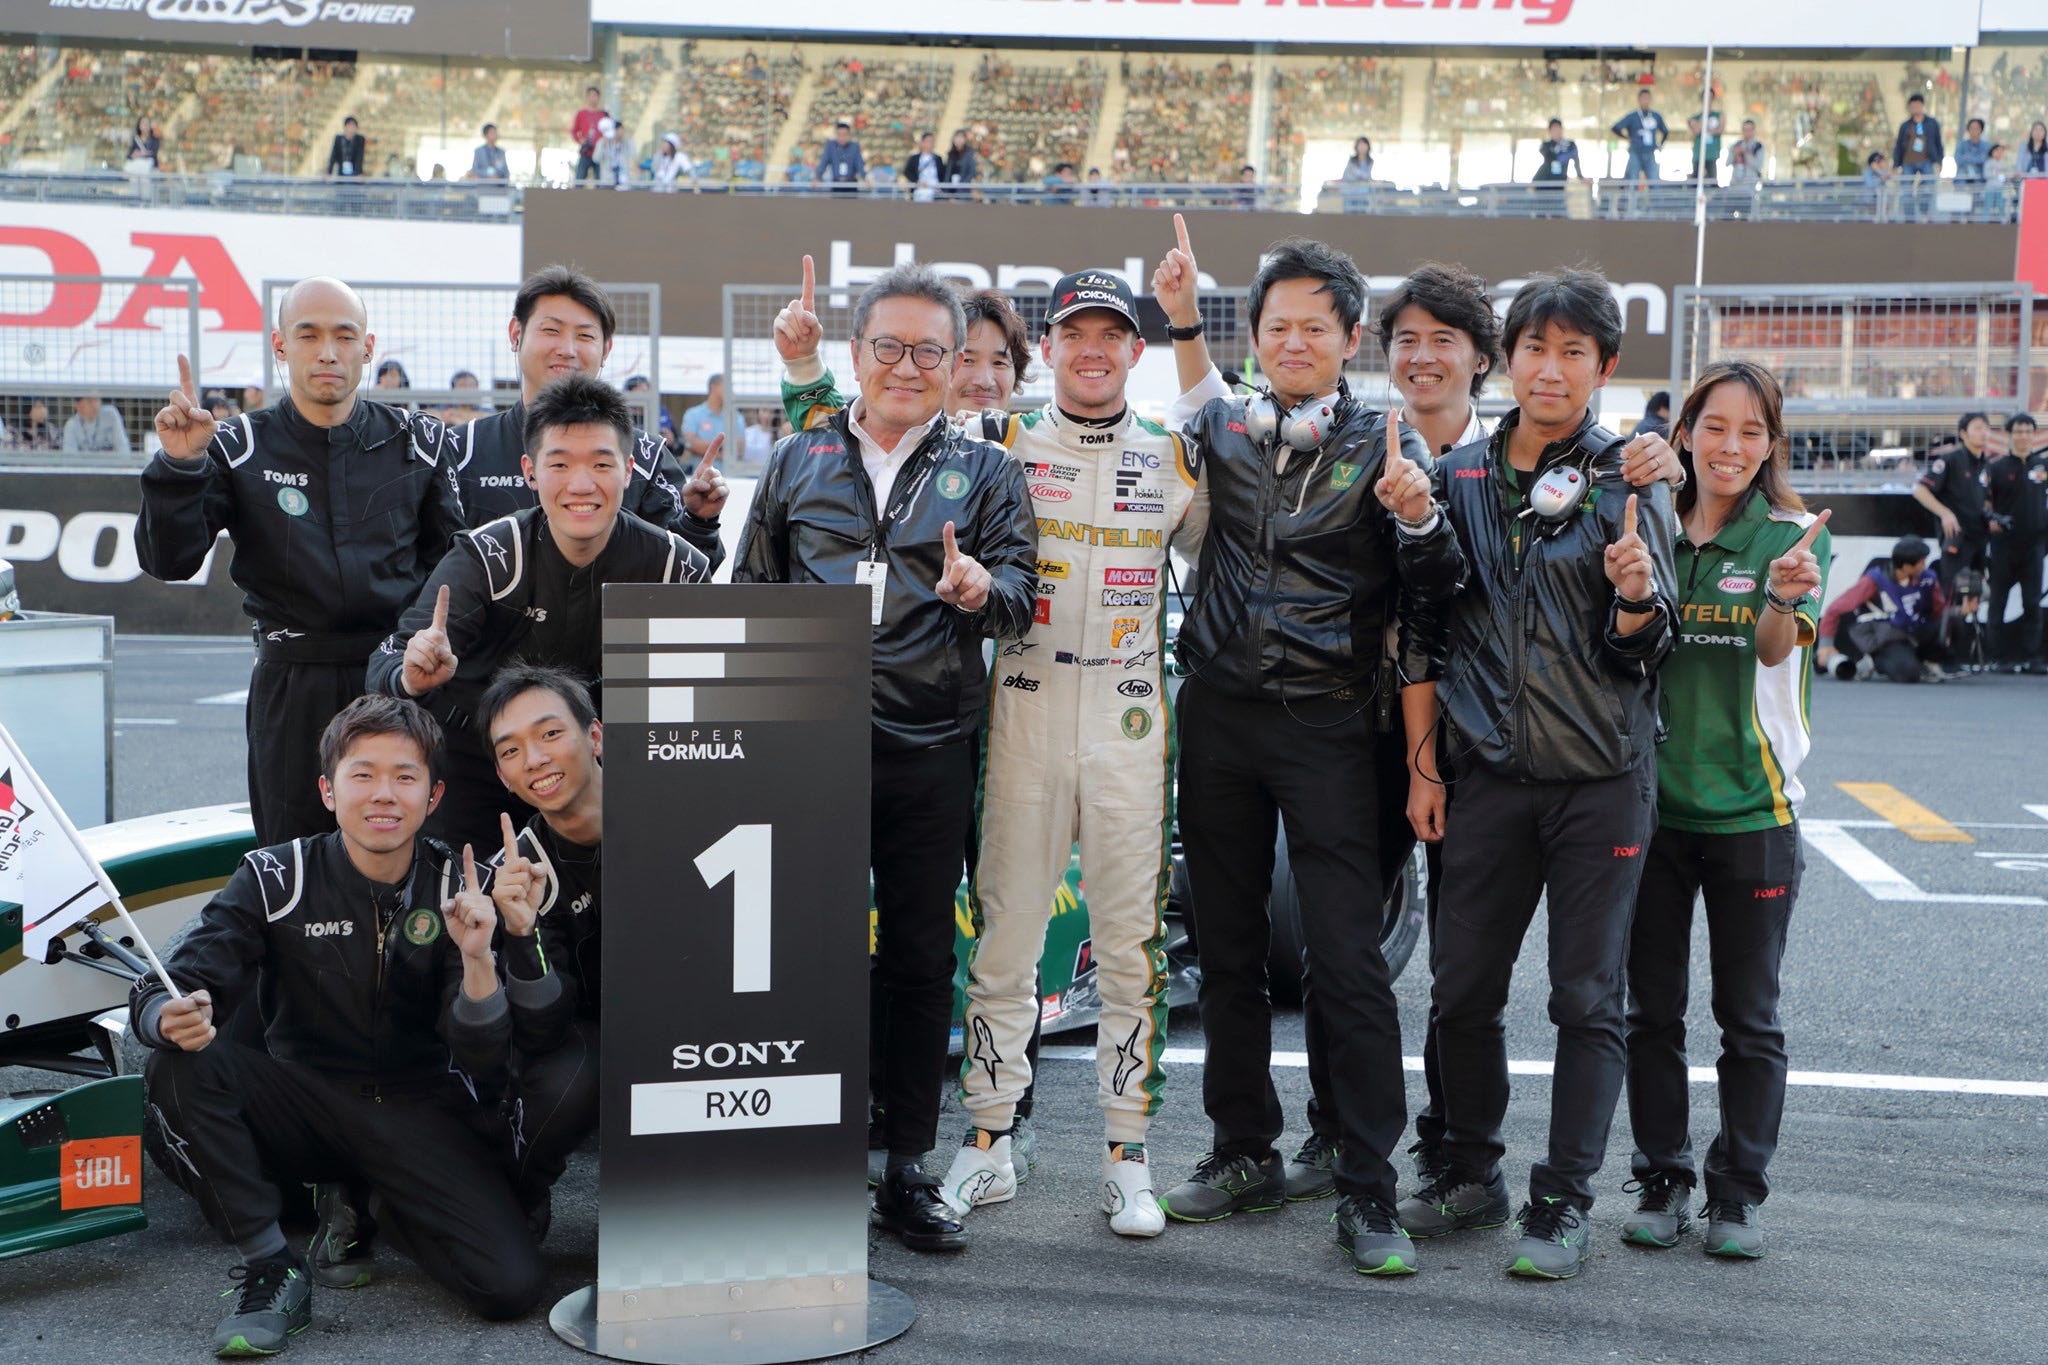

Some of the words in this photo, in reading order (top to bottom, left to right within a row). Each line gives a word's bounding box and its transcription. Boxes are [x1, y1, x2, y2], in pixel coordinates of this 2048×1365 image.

[319, 2, 414, 24] POWER
[1086, 274, 1108, 285] 1st
[1076, 291, 1129, 312] YOKOHAMA
[1079, 434, 1114, 445] TOM'S
[1121, 451, 1161, 469] ENG
[1050, 469, 1078, 477] GAZOO
[1051, 464, 1081, 473] TOYOTA
[263, 469, 309, 487] TOM'S
[480, 475, 525, 488] TOM'S
[1032, 484, 1070, 500] Kowa
[1541, 483, 1564, 499] TOM'S
[1126, 503, 1164, 513] YOKOHAMA
[1107, 570, 1155, 585] MOTUL
[1719, 578, 1755, 591] Kowa
[1102, 589, 1154, 607] KeePer
[1681, 633, 1748, 647] TOM'S
[1081, 657, 1110, 667] CASSIDY
[1120, 680, 1149, 693] Arai
[647, 729, 743, 742] SUPER
[647, 743, 746, 760] FORMULA
[692, 823, 774, 994] 1
[304, 920, 354, 938] TOM'S
[672, 1039, 806, 1070] SONY
[705, 1088, 772, 1119] RX0
[74, 1155, 131, 1189] JBL
